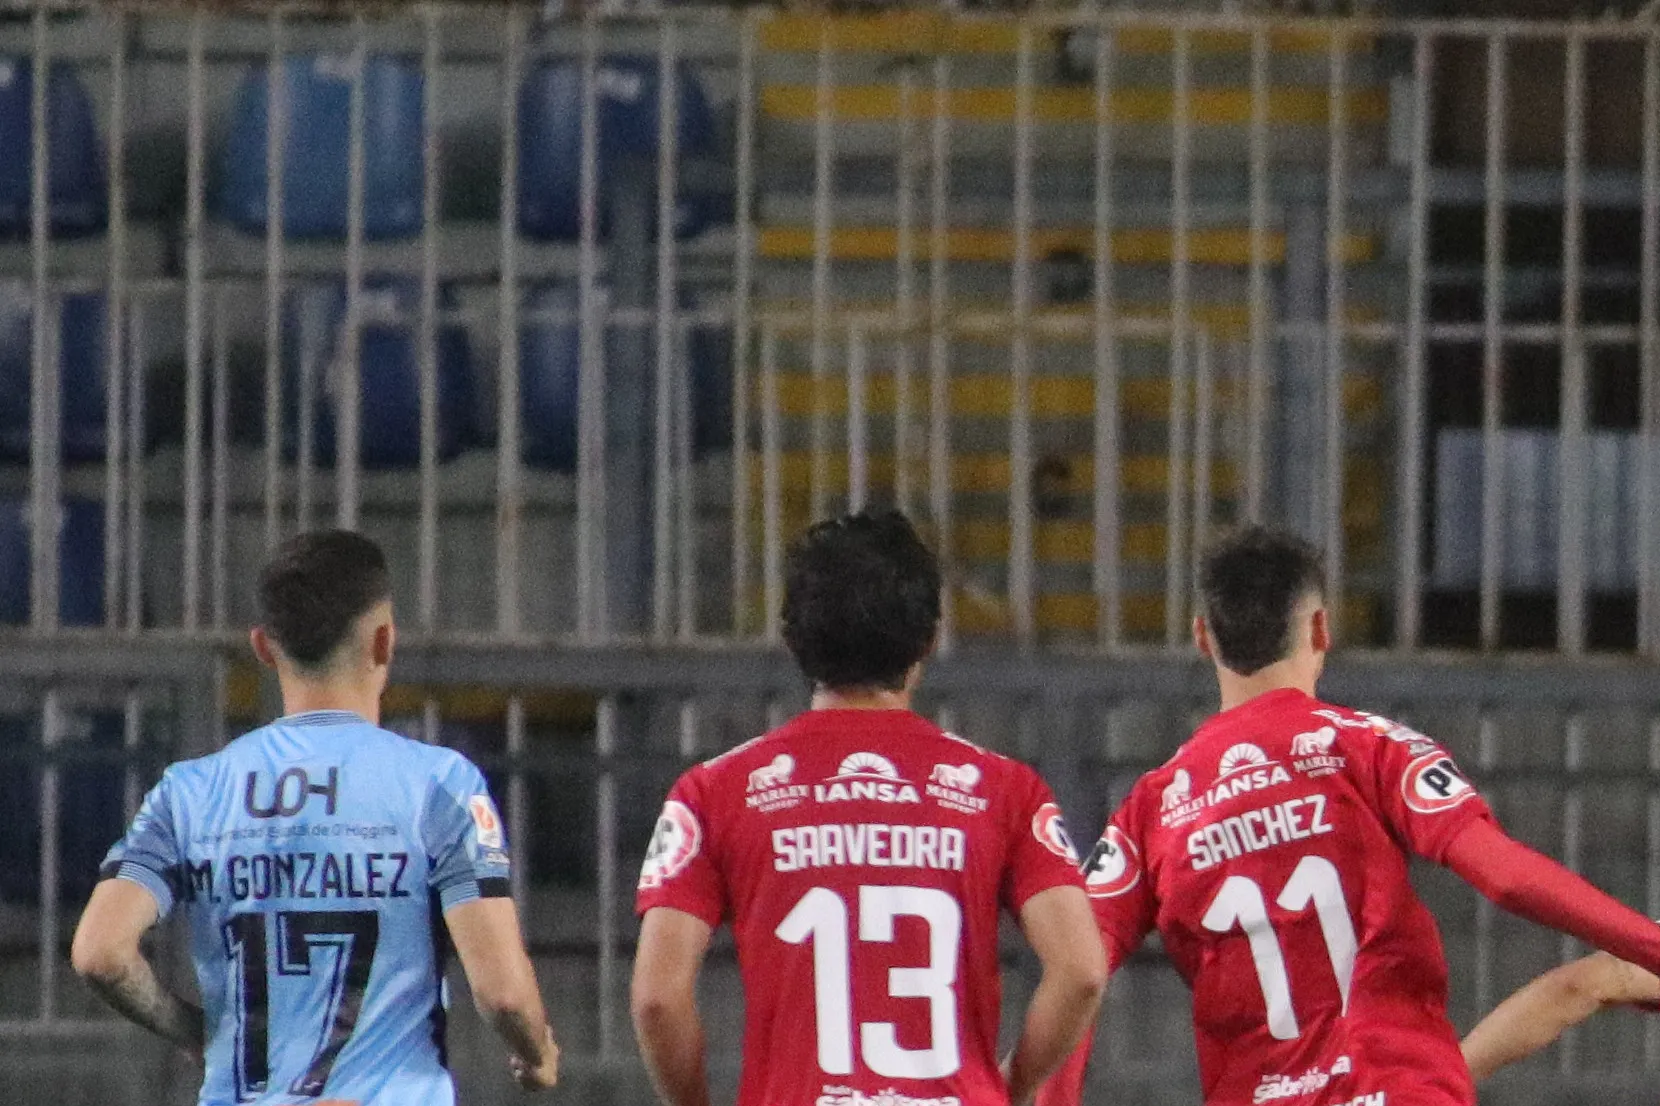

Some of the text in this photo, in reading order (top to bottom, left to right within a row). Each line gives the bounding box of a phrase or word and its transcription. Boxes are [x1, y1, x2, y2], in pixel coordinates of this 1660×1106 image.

[813, 781, 922, 804] IANSA
[1206, 766, 1292, 807] IANSA
[771, 823, 966, 873] SAAVEDRA
[1187, 794, 1334, 871] SANCHEZ
[227, 852, 411, 901] GONZALEZ
[1202, 855, 1360, 1040] 11
[221, 910, 380, 1104] 17
[775, 885, 962, 1080] 13
